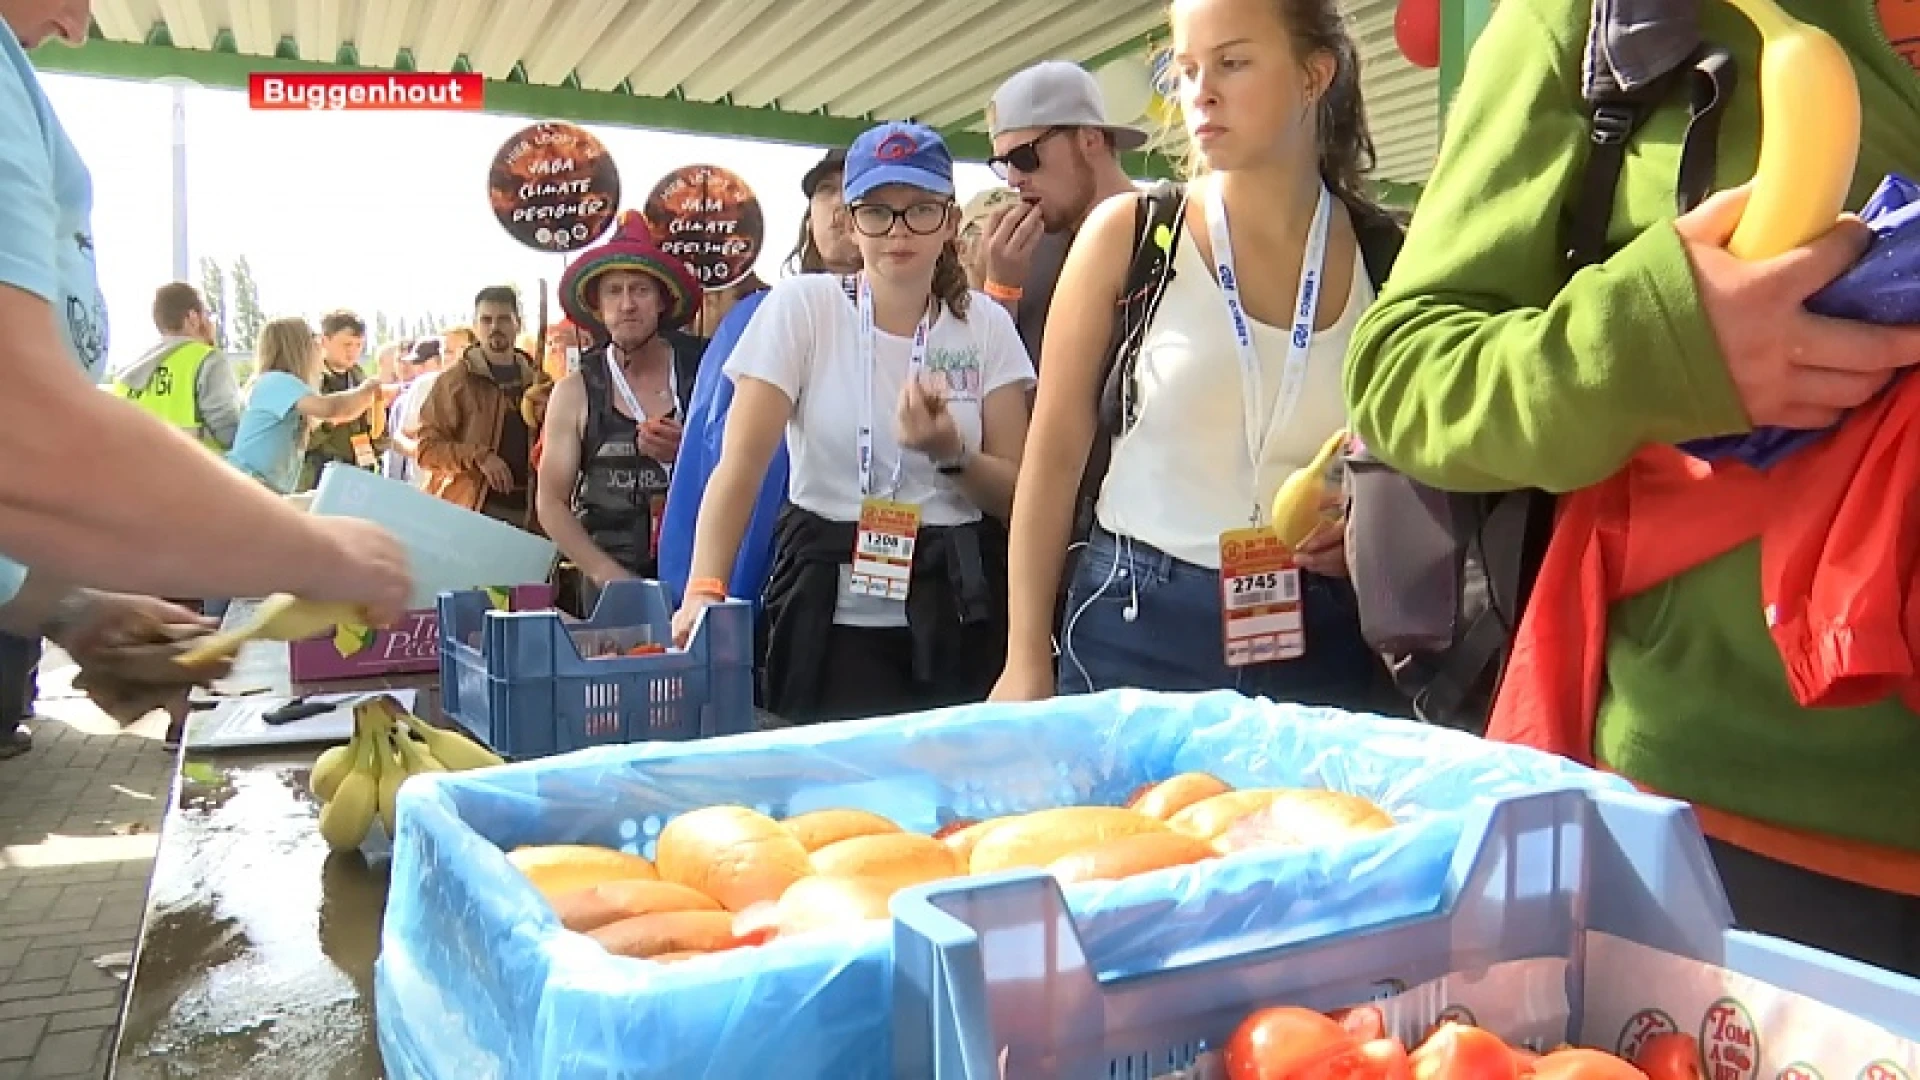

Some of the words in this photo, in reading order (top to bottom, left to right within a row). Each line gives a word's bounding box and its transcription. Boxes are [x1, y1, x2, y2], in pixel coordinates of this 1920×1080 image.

[519, 178, 592, 200] CLIMATE
[512, 198, 604, 222] DESIGNER
[669, 219, 738, 234] CLIMATE
[1233, 573, 1278, 593] 2745
